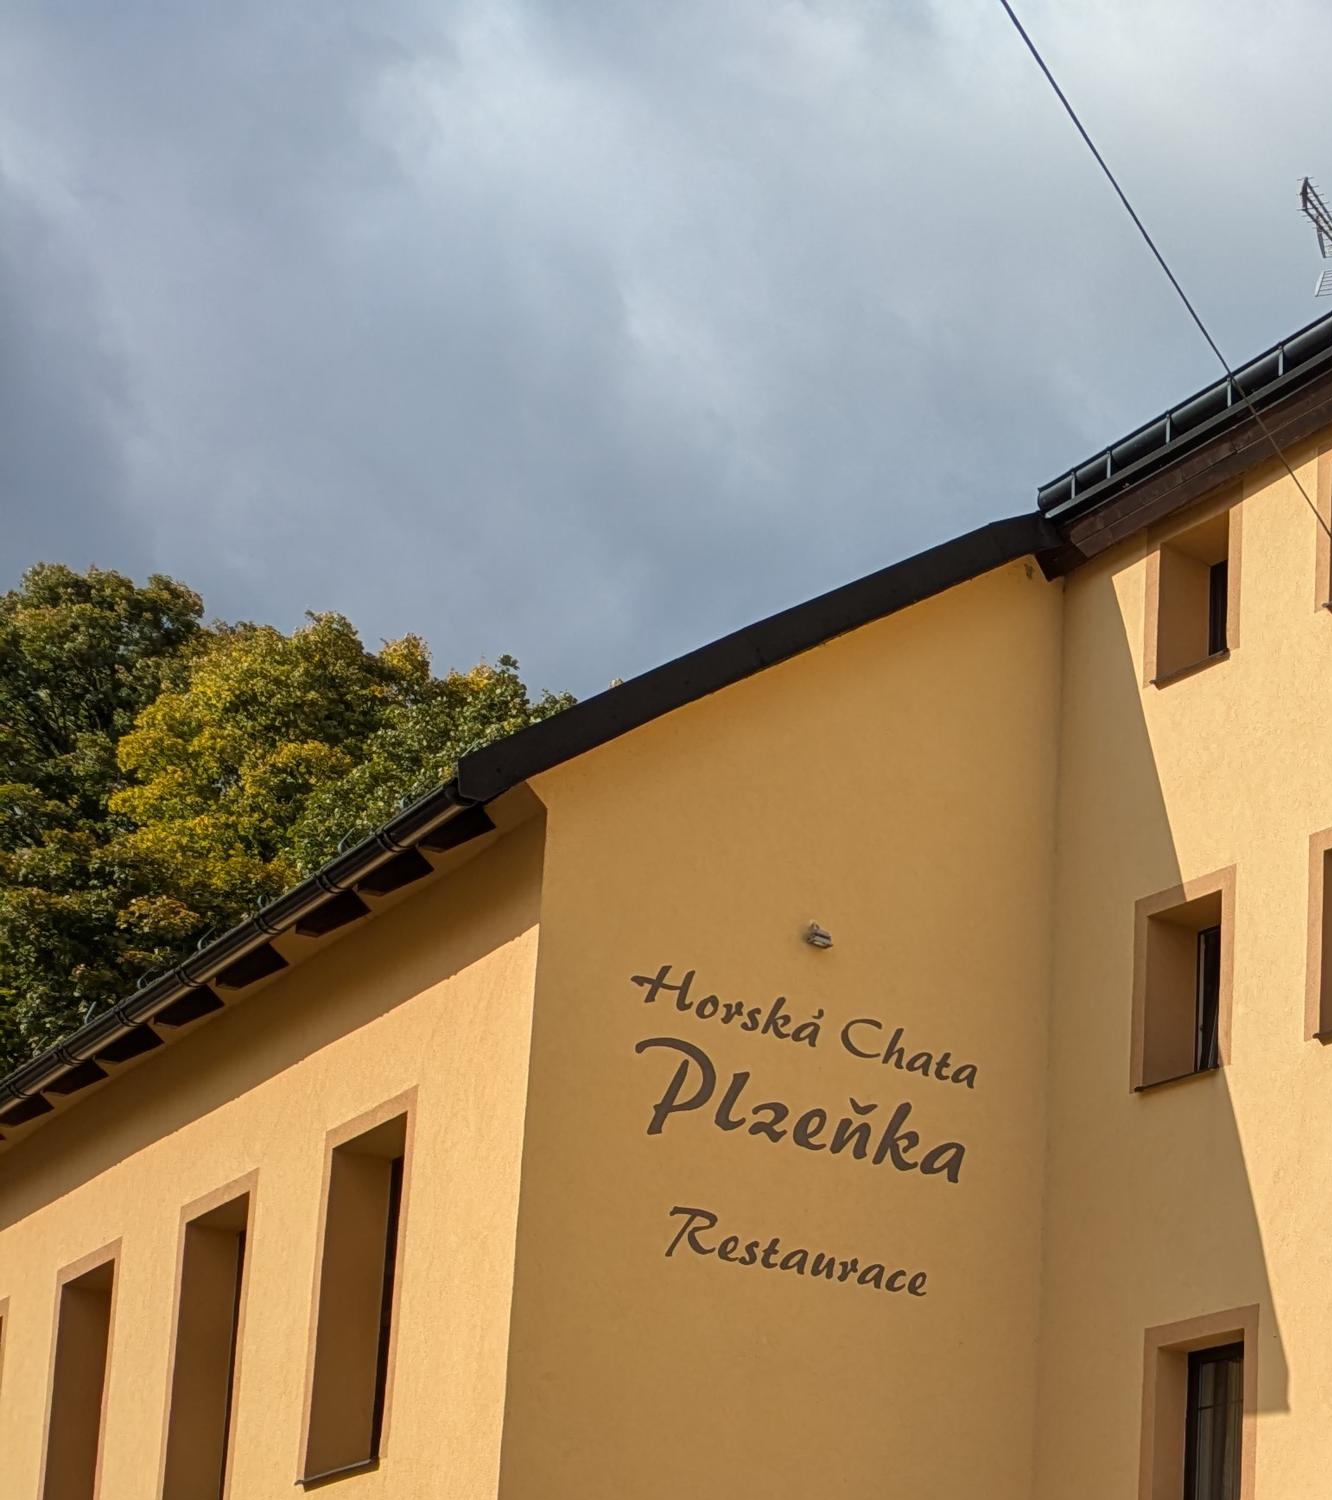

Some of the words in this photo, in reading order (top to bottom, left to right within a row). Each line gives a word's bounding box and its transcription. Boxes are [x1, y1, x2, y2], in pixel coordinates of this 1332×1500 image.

[630, 964, 825, 1047] Horská
[840, 1018, 978, 1089] Chata
[635, 1036, 966, 1184] Plzeňka
[665, 1206, 927, 1297] Restaurace
